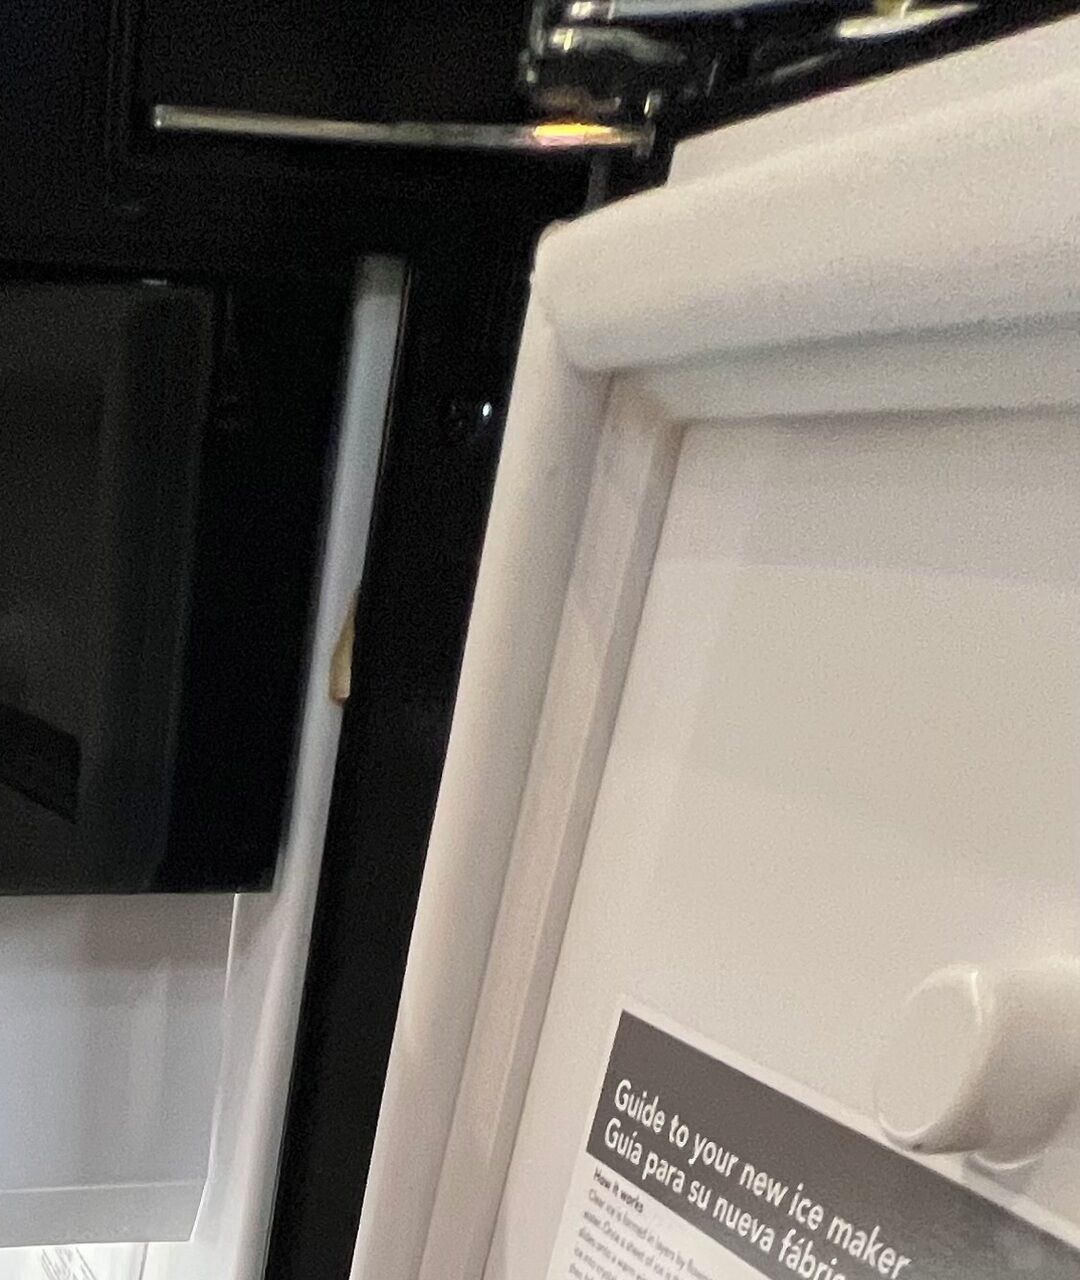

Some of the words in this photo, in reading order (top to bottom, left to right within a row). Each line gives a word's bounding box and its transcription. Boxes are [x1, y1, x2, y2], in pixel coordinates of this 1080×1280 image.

[605, 1118, 642, 1165] Guía
[642, 1151, 685, 1193] para
[687, 1181, 711, 1211] su
[712, 1197, 775, 1254] nueva
[614, 1079, 665, 1133] Guide
[669, 1115, 689, 1148] to
[688, 1133, 739, 1177] your
[739, 1163, 789, 1207] new
[788, 1183, 824, 1231] ice
[826, 1216, 912, 1280] maker
[620, 1190, 644, 1214] works
